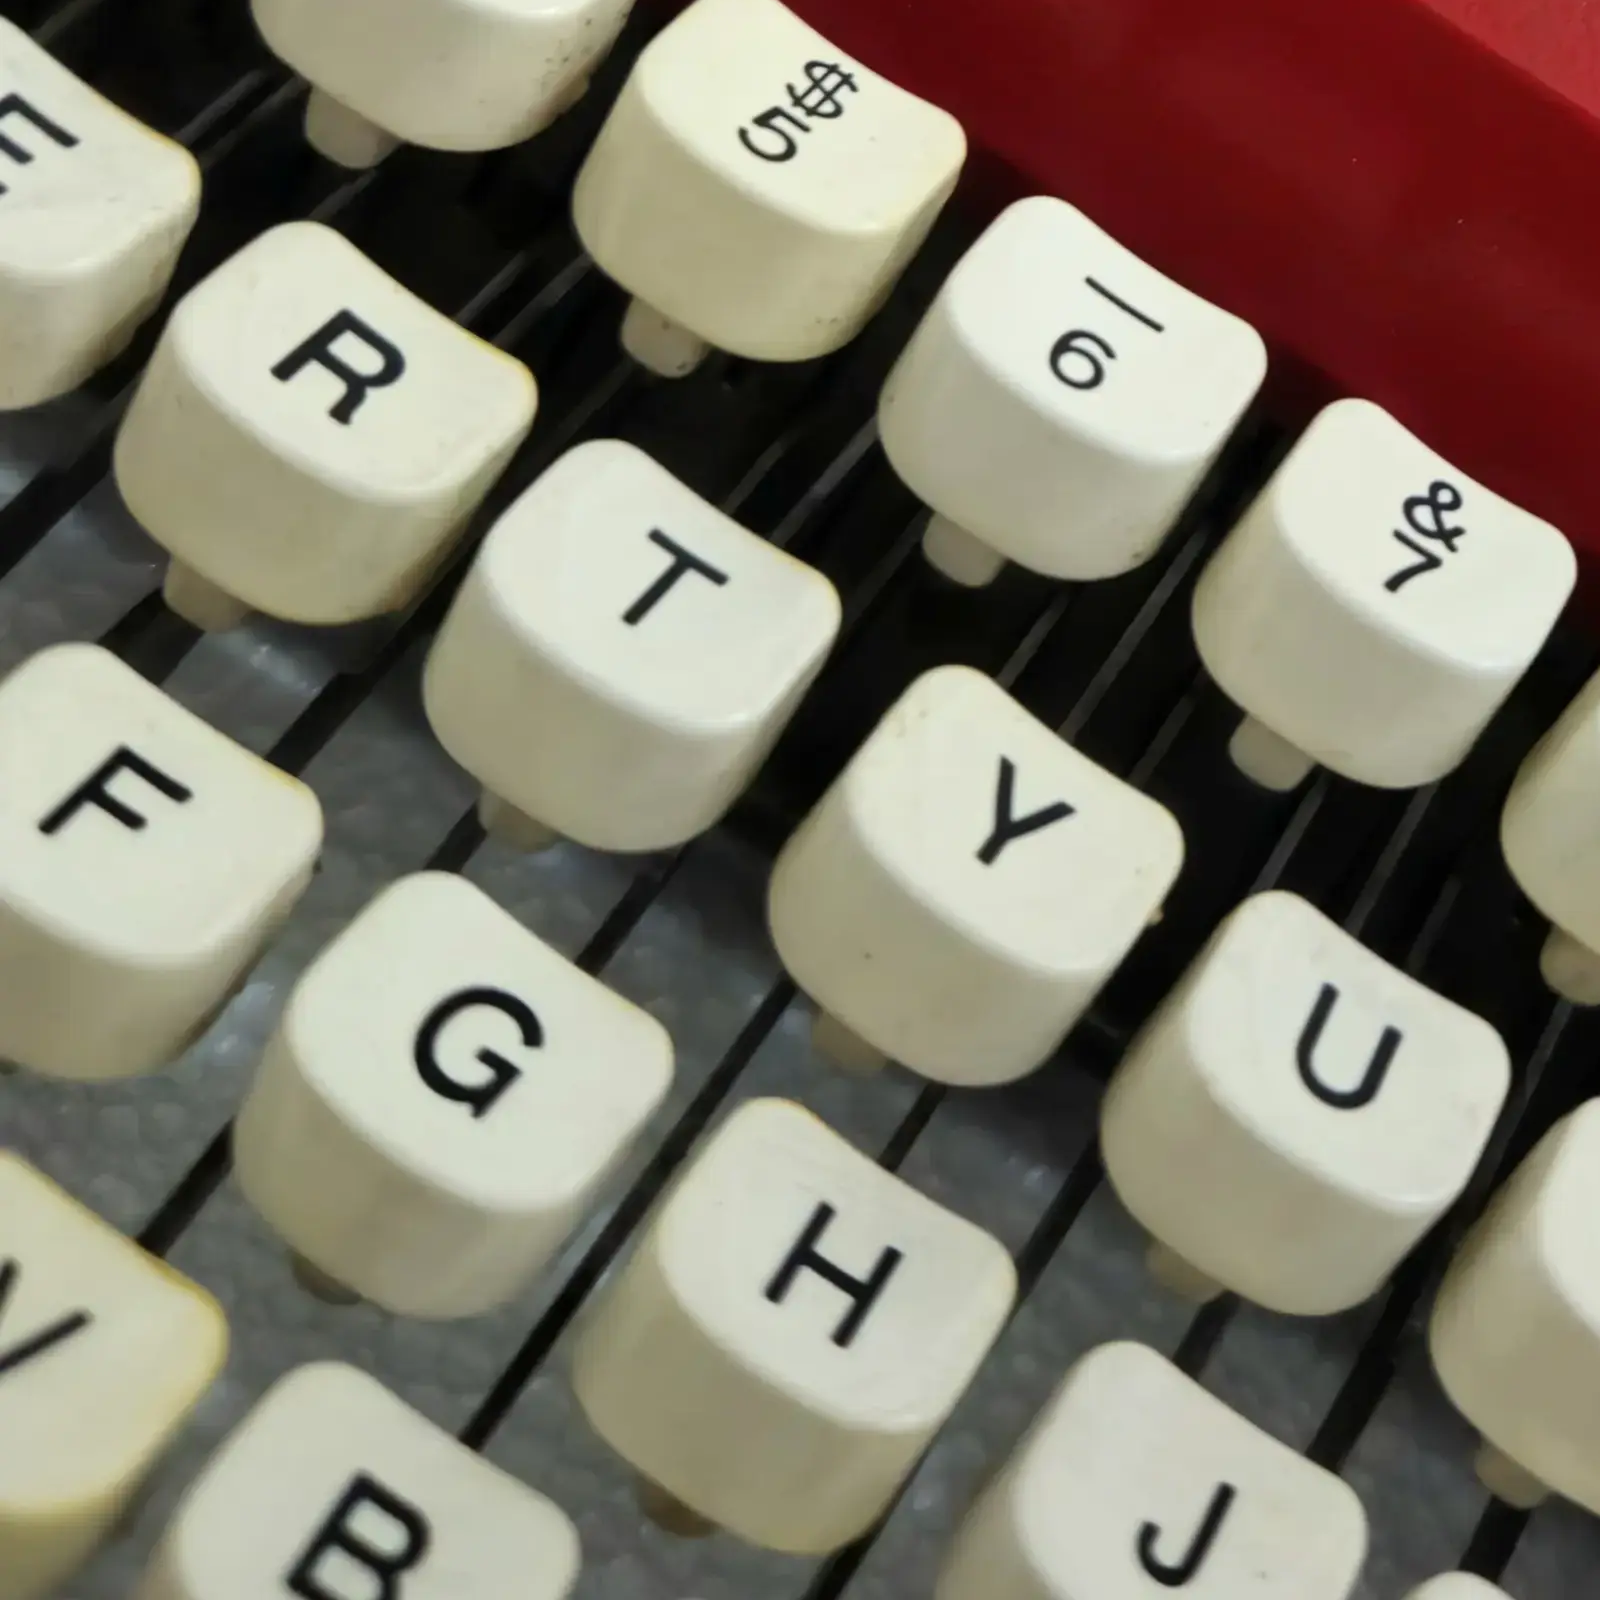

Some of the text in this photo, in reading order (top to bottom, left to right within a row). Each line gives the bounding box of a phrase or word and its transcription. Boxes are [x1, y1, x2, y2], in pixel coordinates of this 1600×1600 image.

[737, 104, 813, 163] 5
[786, 60, 858, 120] $
[270, 308, 406, 426] R
[1048, 329, 1116, 391] 6
[1383, 529, 1443, 593] 7
[1402, 480, 1466, 553] &
[622, 528, 729, 626] T
[37, 745, 193, 837] F
[975, 756, 1075, 866] Y
[413, 986, 544, 1119] G
[1295, 983, 1403, 1111] U
[764, 1201, 904, 1349] H
[284, 1472, 432, 1600] B
[1136, 1482, 1236, 1588] J
